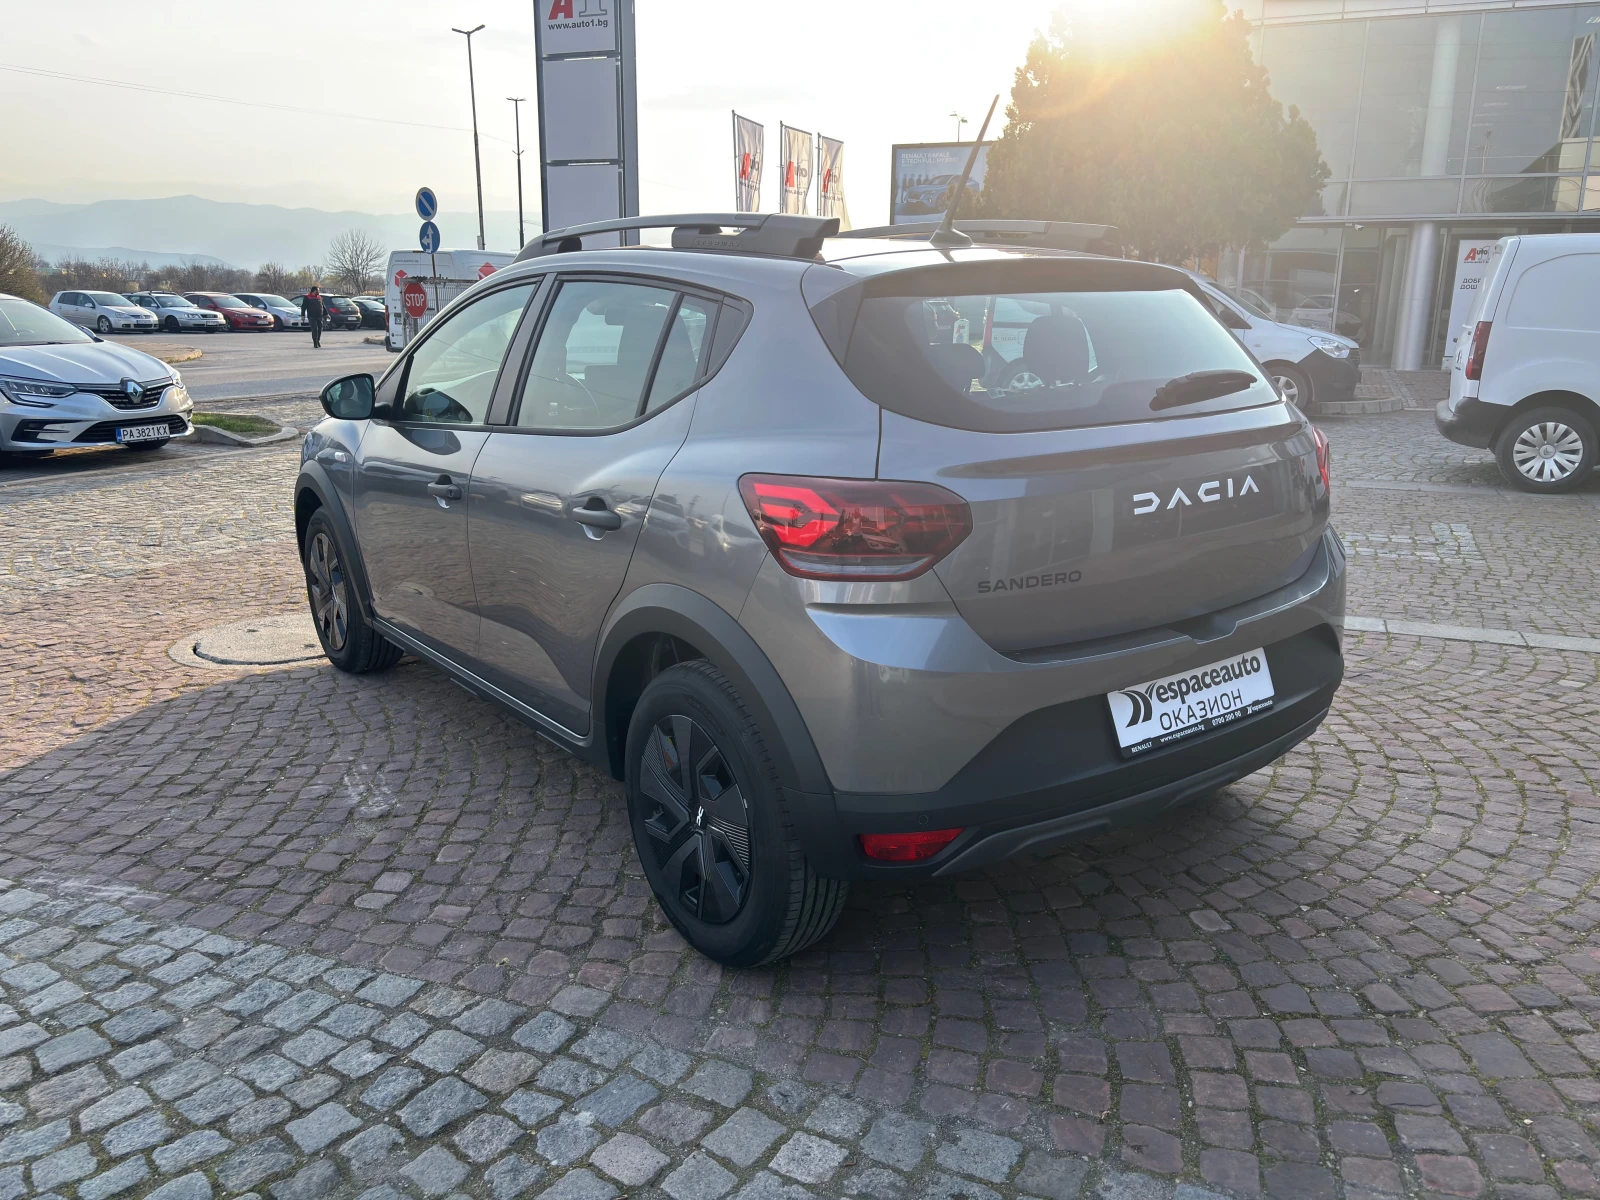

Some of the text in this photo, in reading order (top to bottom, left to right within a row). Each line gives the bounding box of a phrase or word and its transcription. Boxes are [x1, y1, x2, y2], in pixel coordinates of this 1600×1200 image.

[548, 19, 608, 30] www.auto1.bg
[405, 293, 425, 307] STOP
[1133, 475, 1260, 515] DACIA
[977, 570, 1082, 594] SANDERO
[1155, 655, 1261, 704] espaceauto
[1131, 741, 1153, 753] RENAULT
[1160, 724, 1205, 743] www.espaceauto.bg
[1252, 700, 1273, 711] espaceauto
[1159, 688, 1243, 731] ОКАЗИОН
